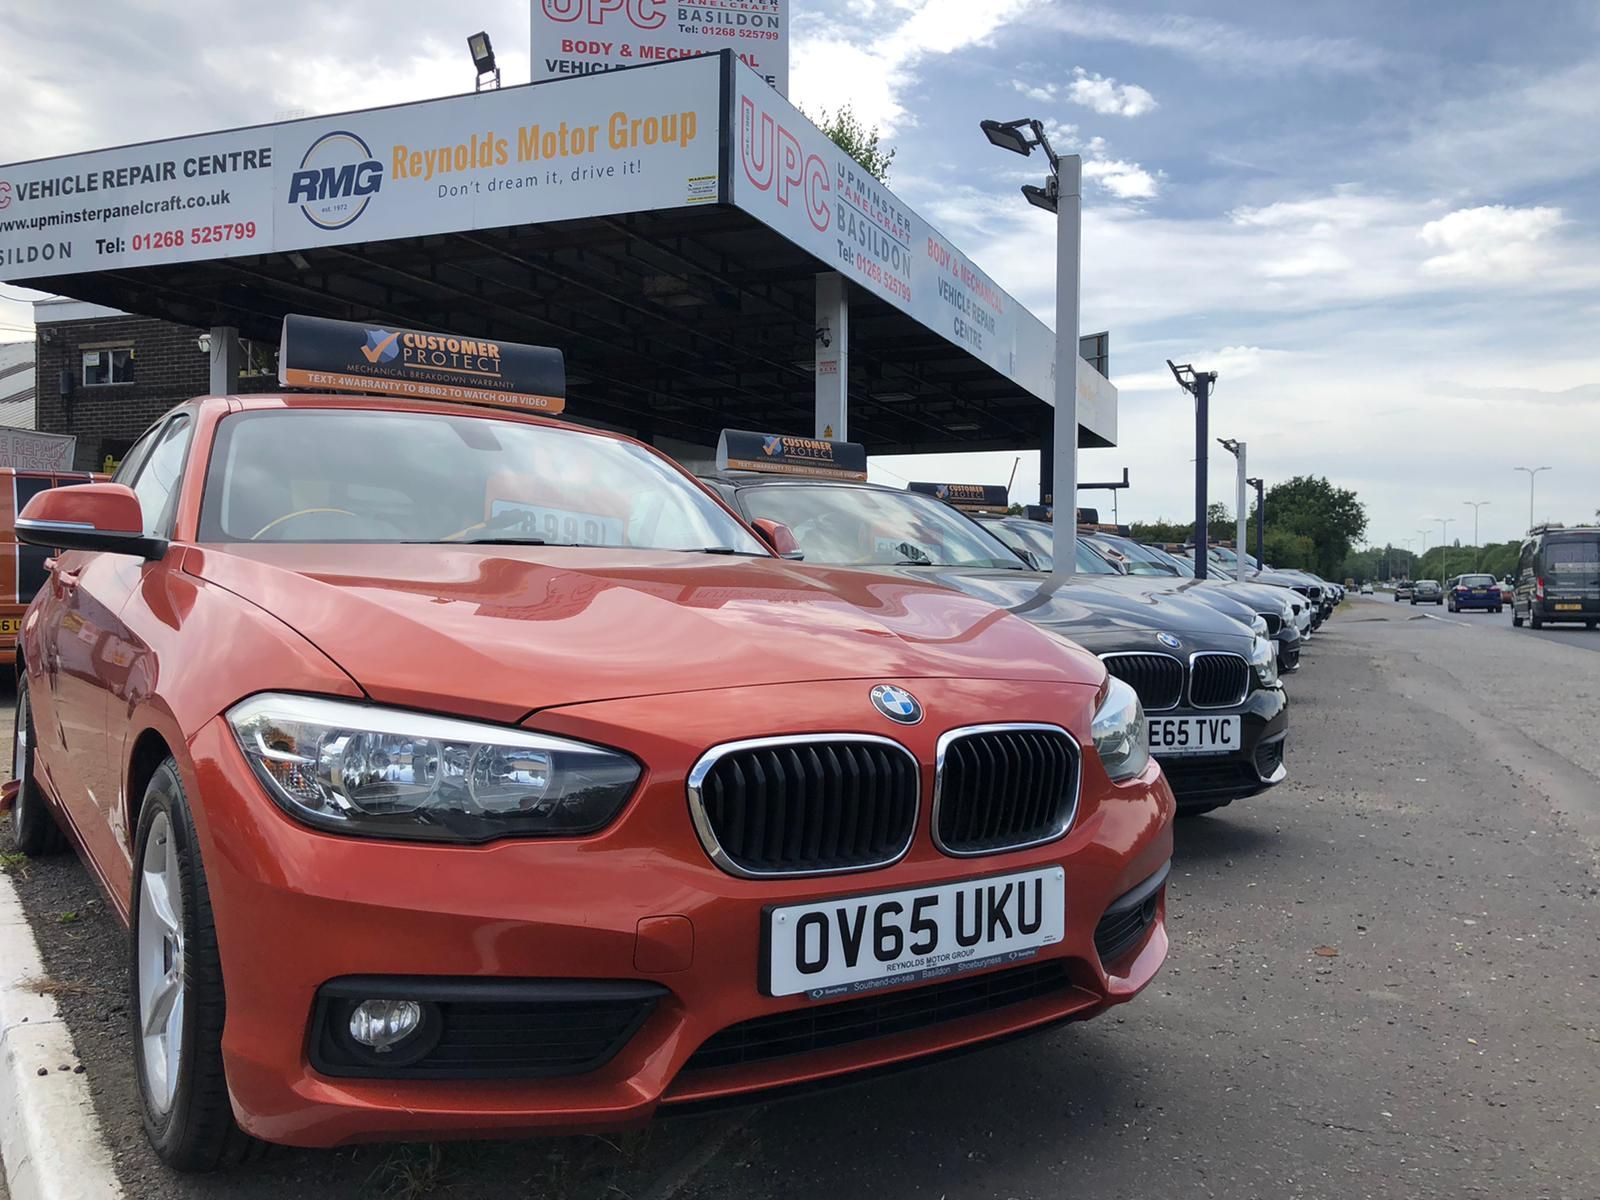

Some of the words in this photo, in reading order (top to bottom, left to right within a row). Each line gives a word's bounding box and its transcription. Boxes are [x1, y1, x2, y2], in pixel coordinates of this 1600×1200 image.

[678, 8, 779, 28] BASILDON
[678, 24, 698, 34] Tel:
[701, 26, 735, 37] 01268
[739, 29, 779, 40] 525799
[562, 39, 613, 55] BODY
[620, 44, 632, 57] &
[639, 45, 759, 67] MECHAL
[392, 131, 508, 181] Reynolds
[518, 122, 599, 162] Motor
[608, 111, 697, 149] Group
[741, 95, 831, 232] UPC
[16, 172, 98, 201] VEHICLE
[102, 161, 176, 189] REPAIR
[183, 147, 272, 178] CENTRE
[288, 161, 383, 204] RMG
[438, 180, 480, 198] Don't
[488, 175, 538, 192] dream
[546, 170, 563, 185] it,
[571, 167, 615, 182] drive
[623, 160, 641, 175] it!
[0, 190, 230, 232] ww.upminsterpanelcraft.co.uk
[837, 162, 911, 233] UPMINSTER
[837, 178, 911, 245] PANELCRAFT
[96, 239, 125, 254] Tel:
[132, 230, 184, 251] 01268
[191, 221, 256, 245] 525799
[837, 202, 911, 279] BASILDON
[837, 238, 854, 266] Tel:
[856, 253, 881, 283] 01268
[884, 271, 911, 302] 525799
[927, 236, 951, 270] BODY
[961, 264, 1004, 315] MECHANICAL
[938, 276, 971, 317] VEHICLE
[972, 302, 996, 336] REPAIR
[403, 332, 500, 358] CUSTOMER
[953, 316, 982, 351] CENTRE
[347, 363, 407, 378] MECHANICAL
[409, 371, 466, 384] BREAKDOWN
[470, 378, 515, 389] WARRANTY
[403, 348, 501, 372] PROTECT
[308, 373, 336, 385] TEXT:
[338, 376, 400, 391] 4WARRANTY
[403, 383, 416, 393] TO
[418, 386, 448, 396] 88802
[449, 389, 462, 397] TO
[463, 390, 496, 401] WATCH
[498, 394, 518, 404] OUR
[519, 396, 548, 407] VIDEO
[783, 437, 832, 451] CUSTOMER
[783, 447, 833, 459] PROTECT
[1149, 720, 1189, 746] E65
[1196, 718, 1231, 745] TVC
[796, 895, 939, 975] OV65
[956, 878, 1042, 947] UKU
[886, 959, 925, 972] REYNOLDS
[926, 953, 951, 966] MOTOR
[952, 948, 976, 960] GROUP
[854, 973, 915, 991] Southend-on-sea
[922, 967, 951, 978] Basildon
